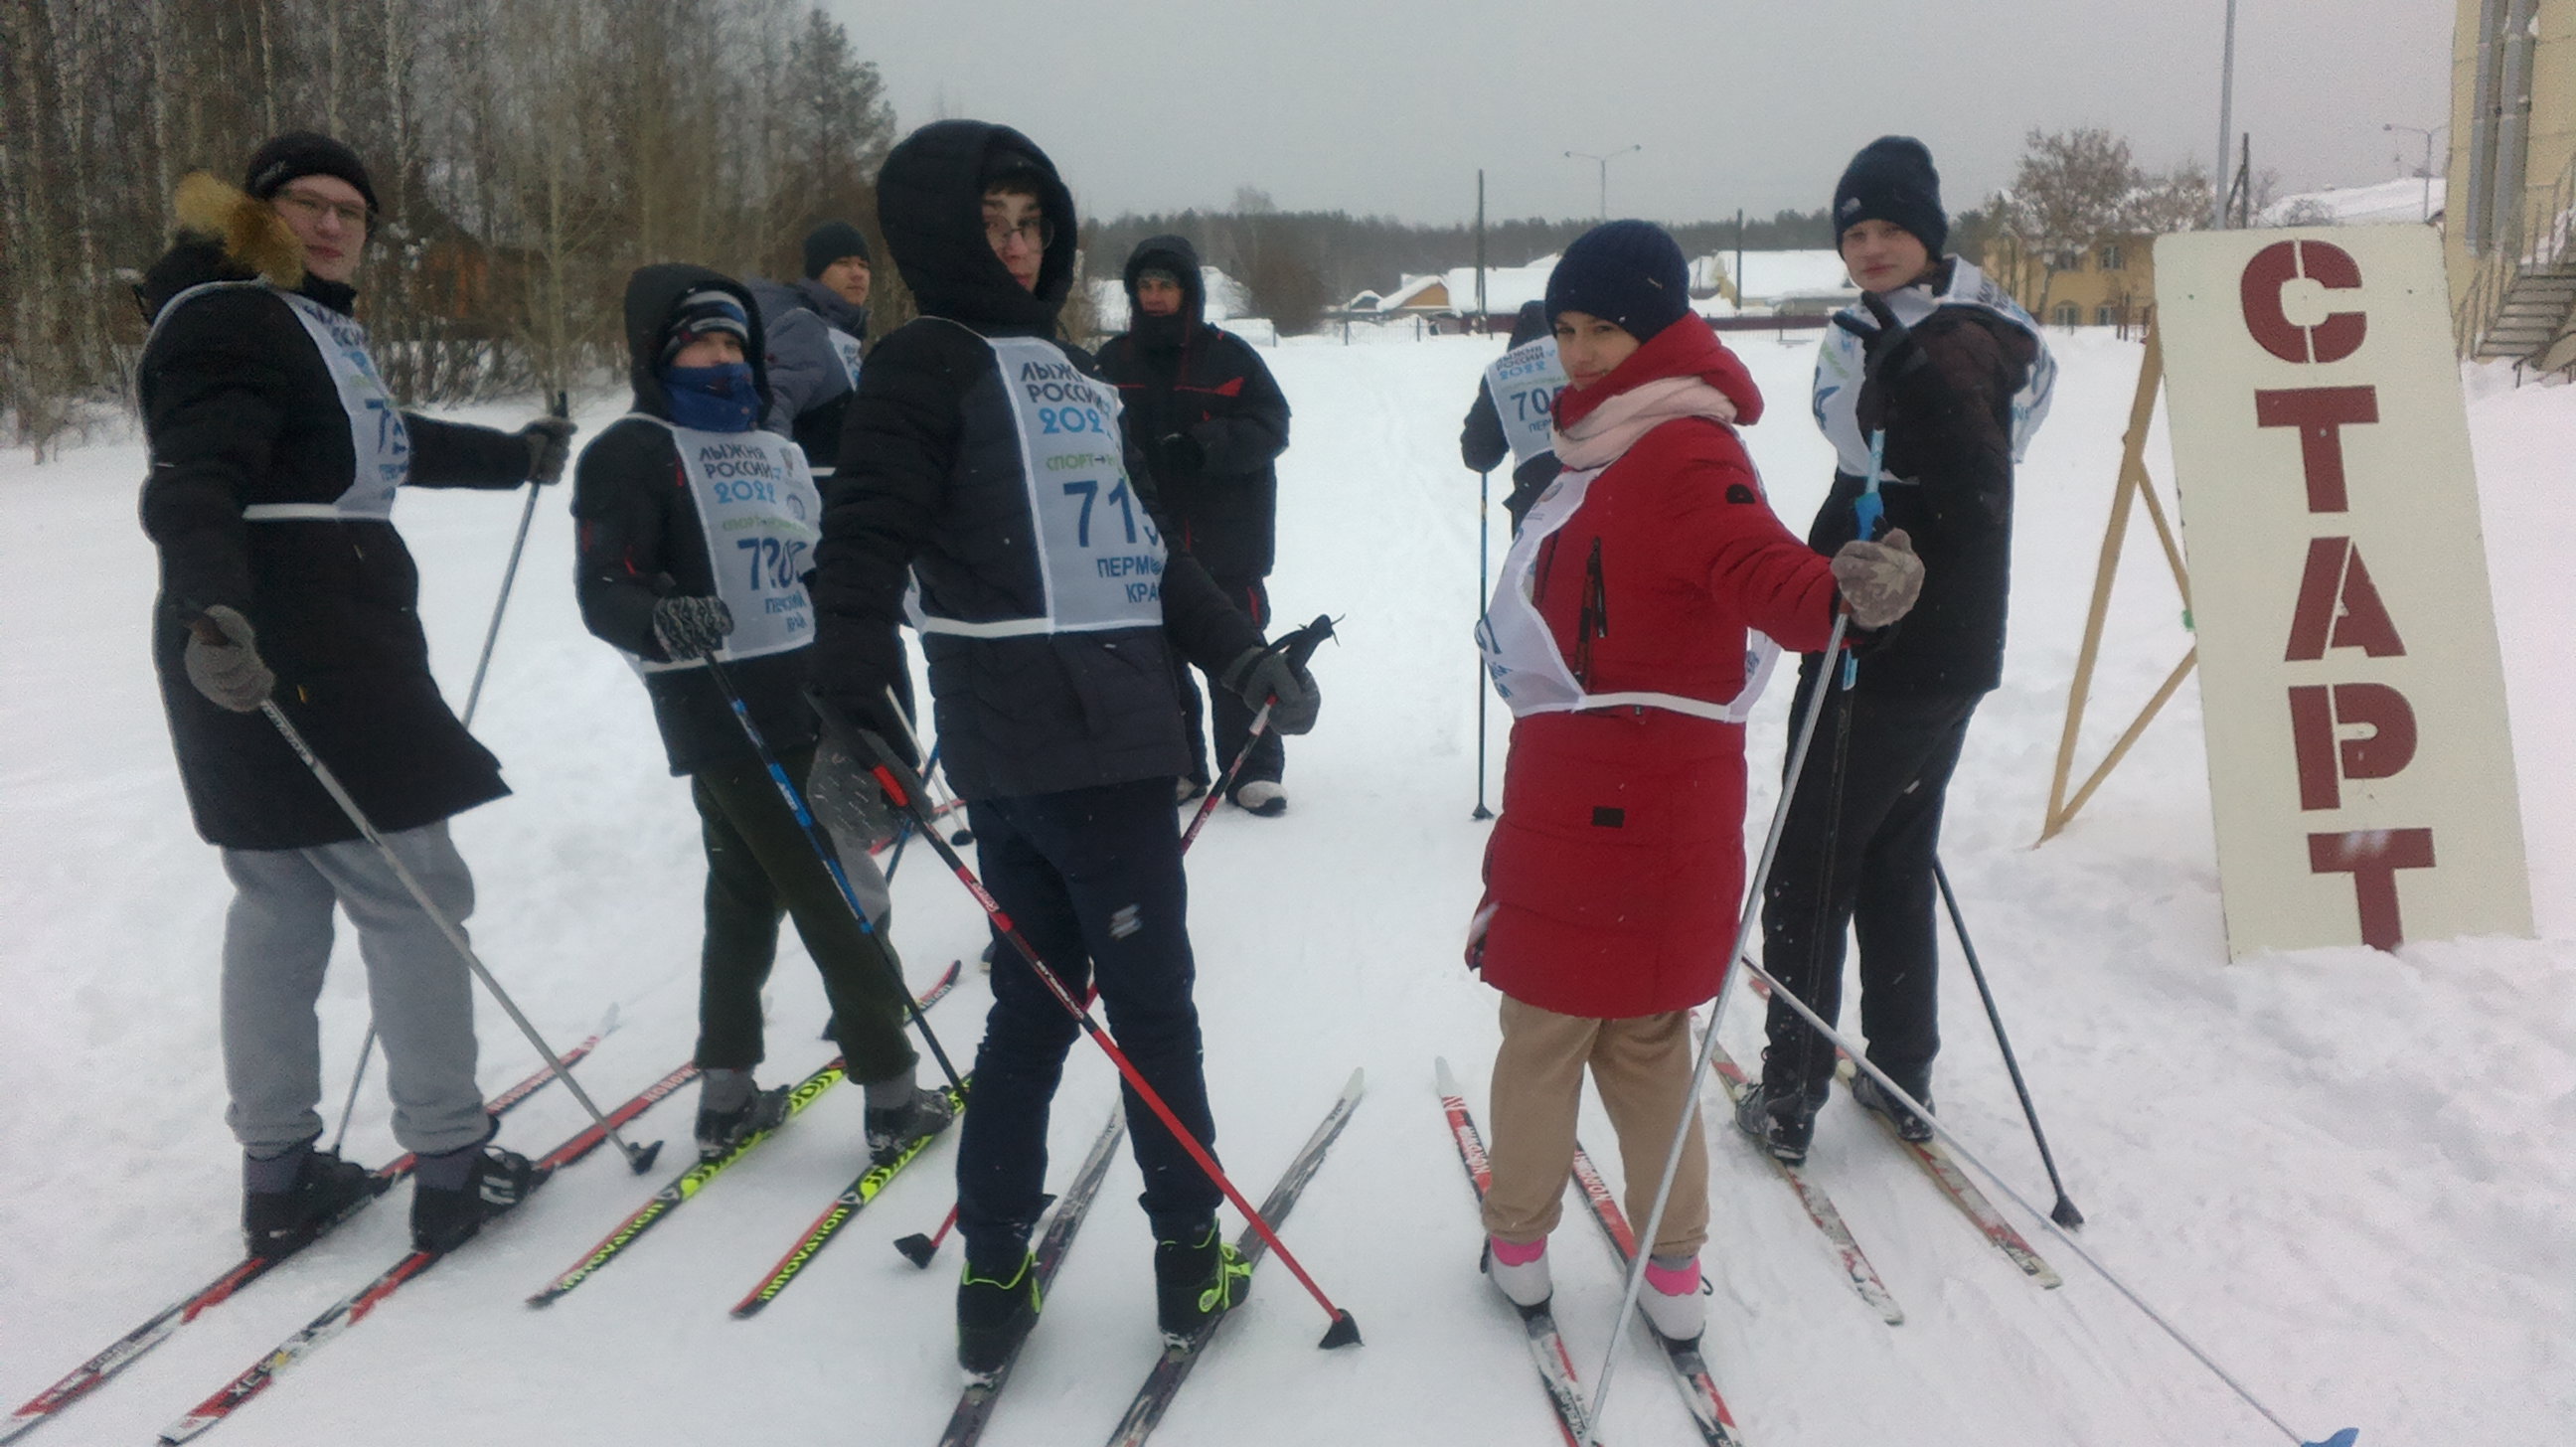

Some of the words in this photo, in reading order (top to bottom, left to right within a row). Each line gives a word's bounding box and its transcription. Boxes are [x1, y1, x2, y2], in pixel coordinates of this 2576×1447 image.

[1020, 361, 1085, 383] ЛЫЖ
[1039, 406, 1114, 441] 202
[699, 444, 766, 462] ЛЫЖНЯ
[704, 461, 773, 479] РОССИИ
[714, 479, 777, 504] 2022
[2239, 239, 2438, 952] СТАРТ
